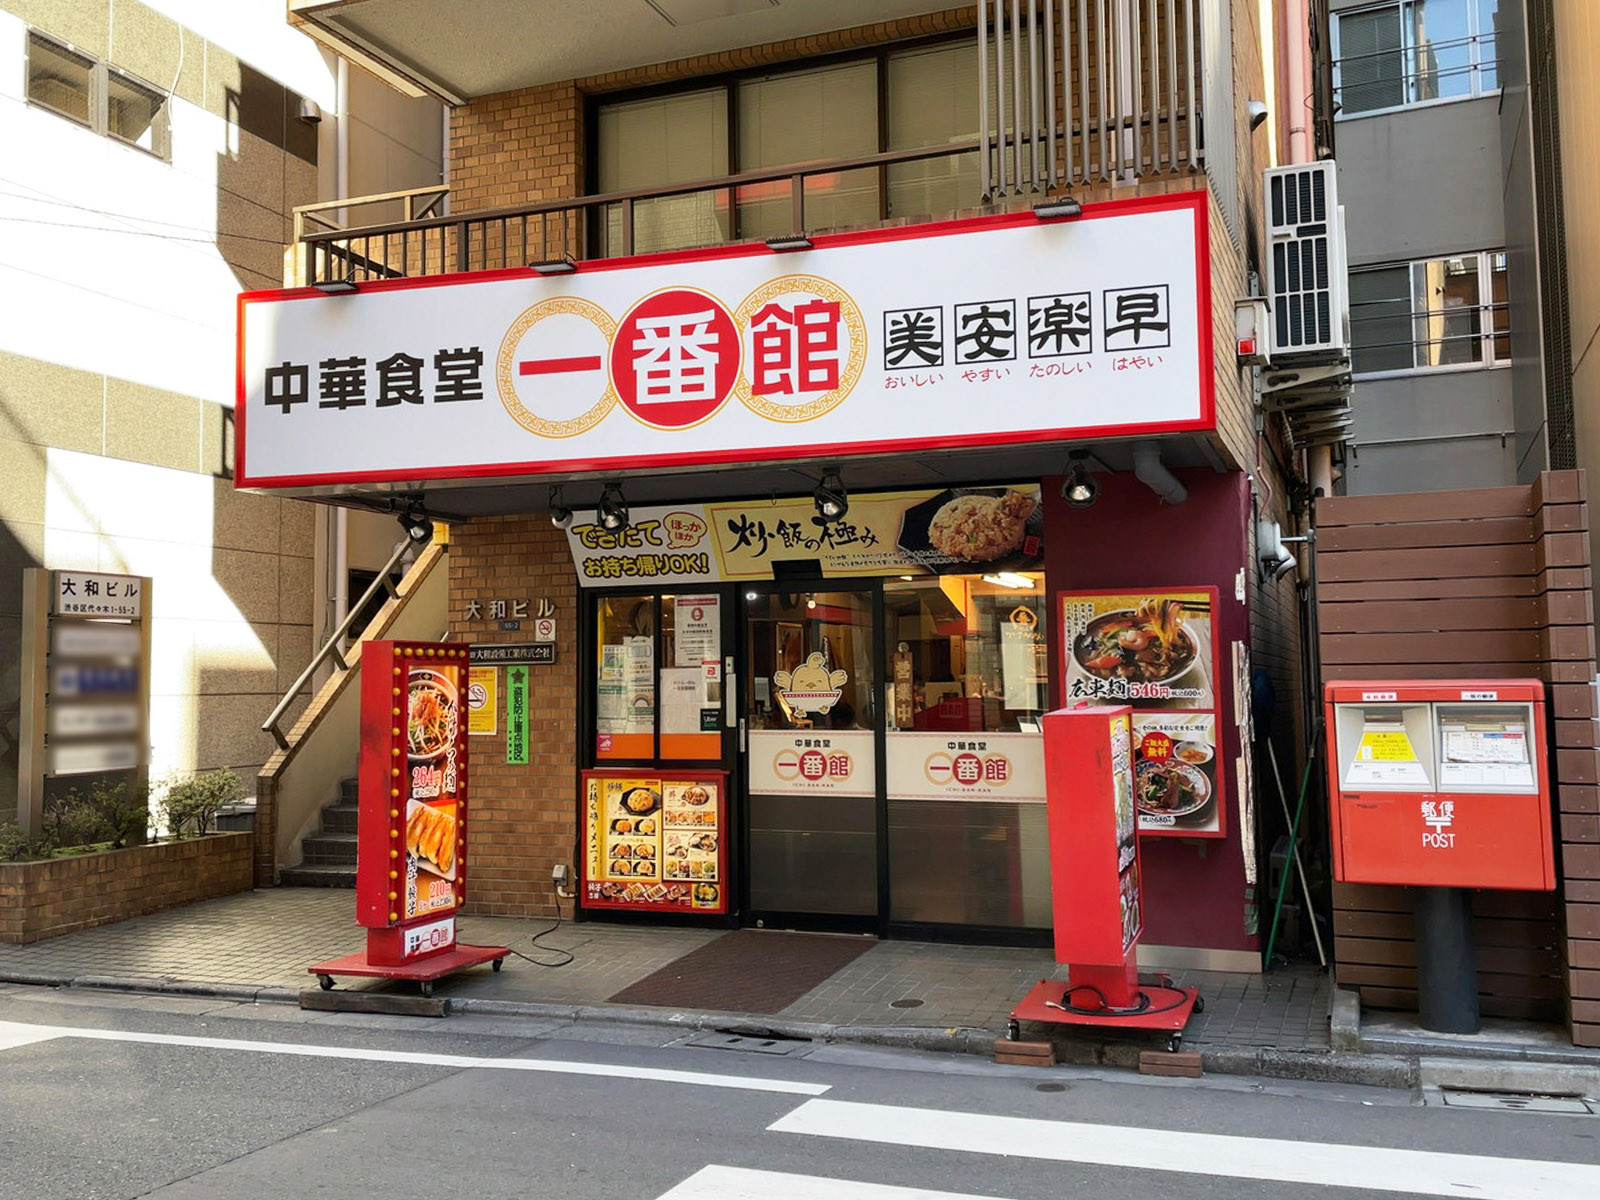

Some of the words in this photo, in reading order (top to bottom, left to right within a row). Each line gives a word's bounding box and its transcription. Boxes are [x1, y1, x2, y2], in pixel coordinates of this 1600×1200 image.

[885, 313, 943, 367] 美
[956, 306, 1015, 361] 安
[1029, 298, 1091, 353] 楽
[1104, 292, 1169, 345] 早
[264, 346, 484, 414] 中華食堂
[519, 299, 841, 405] 一番館
[884, 372, 944, 389] おいしい
[961, 367, 1010, 383] やすい
[1029, 360, 1092, 378] たのしい
[1112, 354, 1163, 371] はやい
[671, 519, 701, 532] ほっか
[583, 552, 710, 578] お持ち帰りOK!
[62, 578, 138, 597] 大和ビル
[64, 603, 135, 615] 渋谷区代々木1-55-2
[466, 598, 555, 620] 大和ビル
[1131, 683, 1169, 698] 546円
[795, 739, 831, 748] 中華食堂
[948, 741, 987, 750] 中華食堂
[778, 754, 849, 777] 一番館
[930, 758, 1006, 781] 一番館
[1421, 801, 1455, 818] 郵便
[1422, 833, 1456, 848] POST
